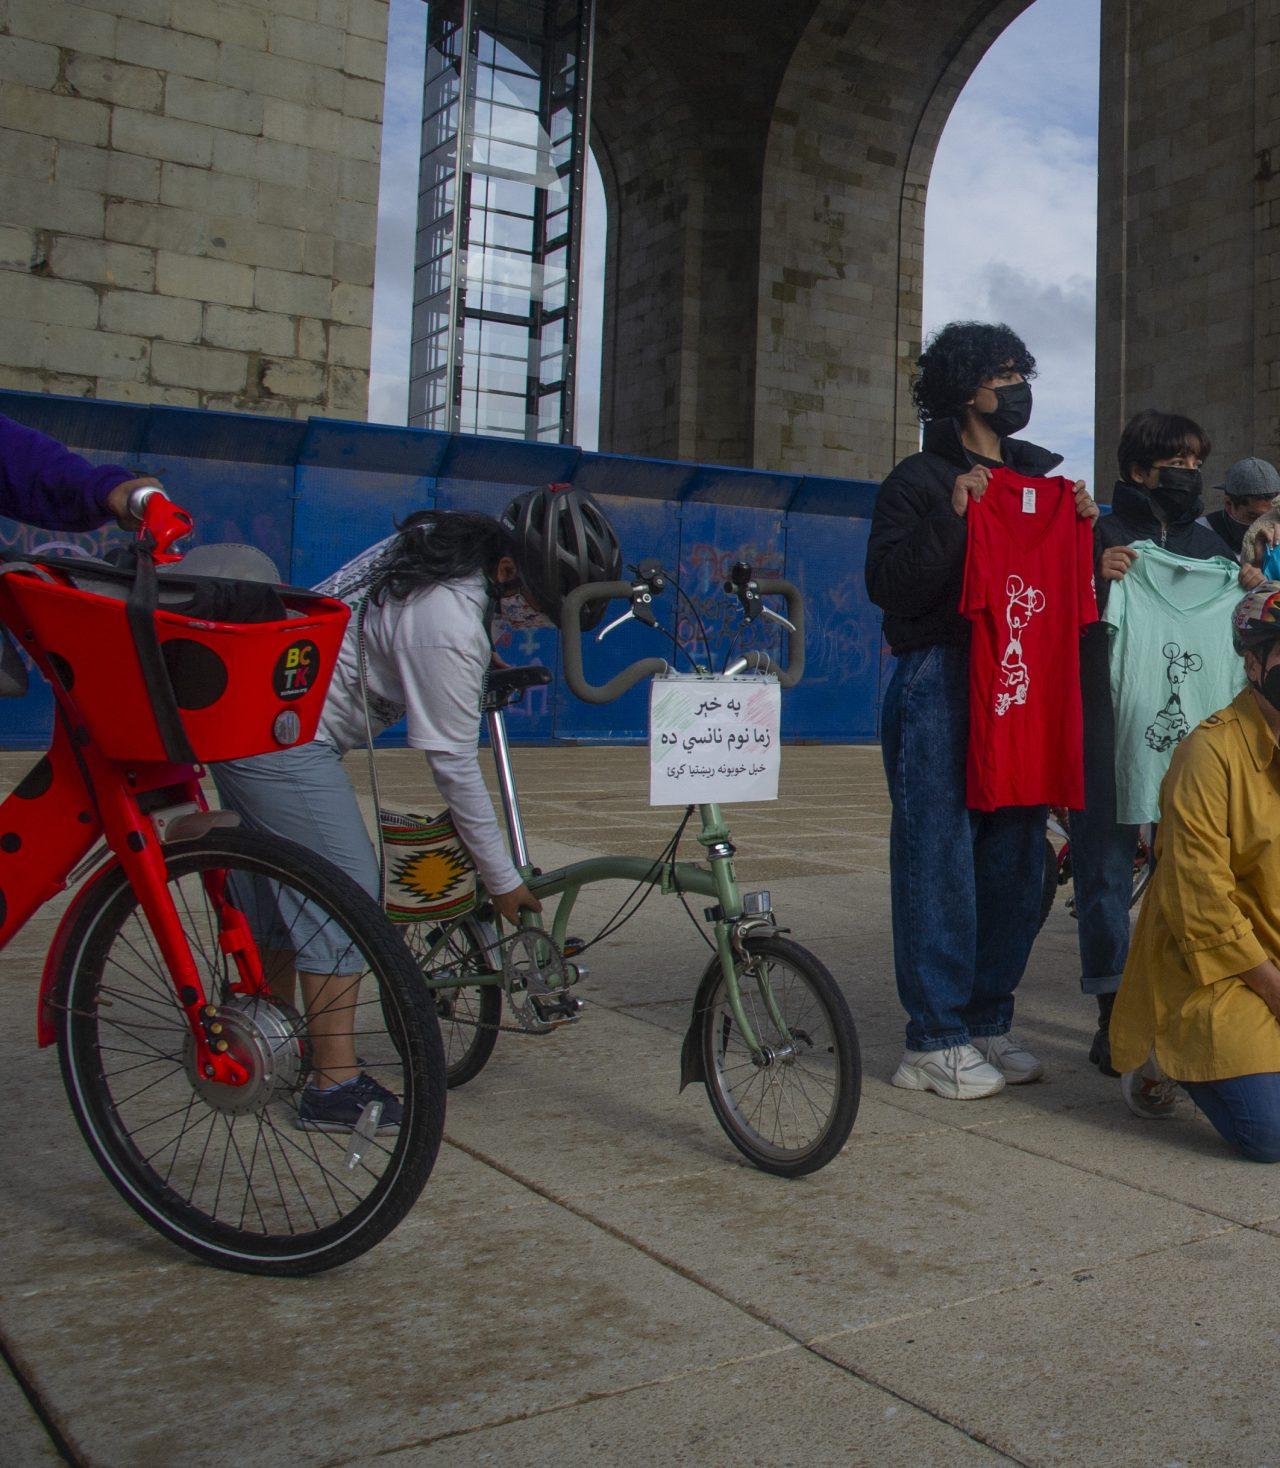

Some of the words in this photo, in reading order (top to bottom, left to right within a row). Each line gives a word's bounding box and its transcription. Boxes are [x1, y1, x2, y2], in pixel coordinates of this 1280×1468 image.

[286, 646, 312, 668] BC
[284, 668, 309, 689] TK
[727, 698, 741, 718] په
[661, 732, 678, 745] ده
[728, 728, 749, 751] نوم
[753, 728, 771, 748] زما
